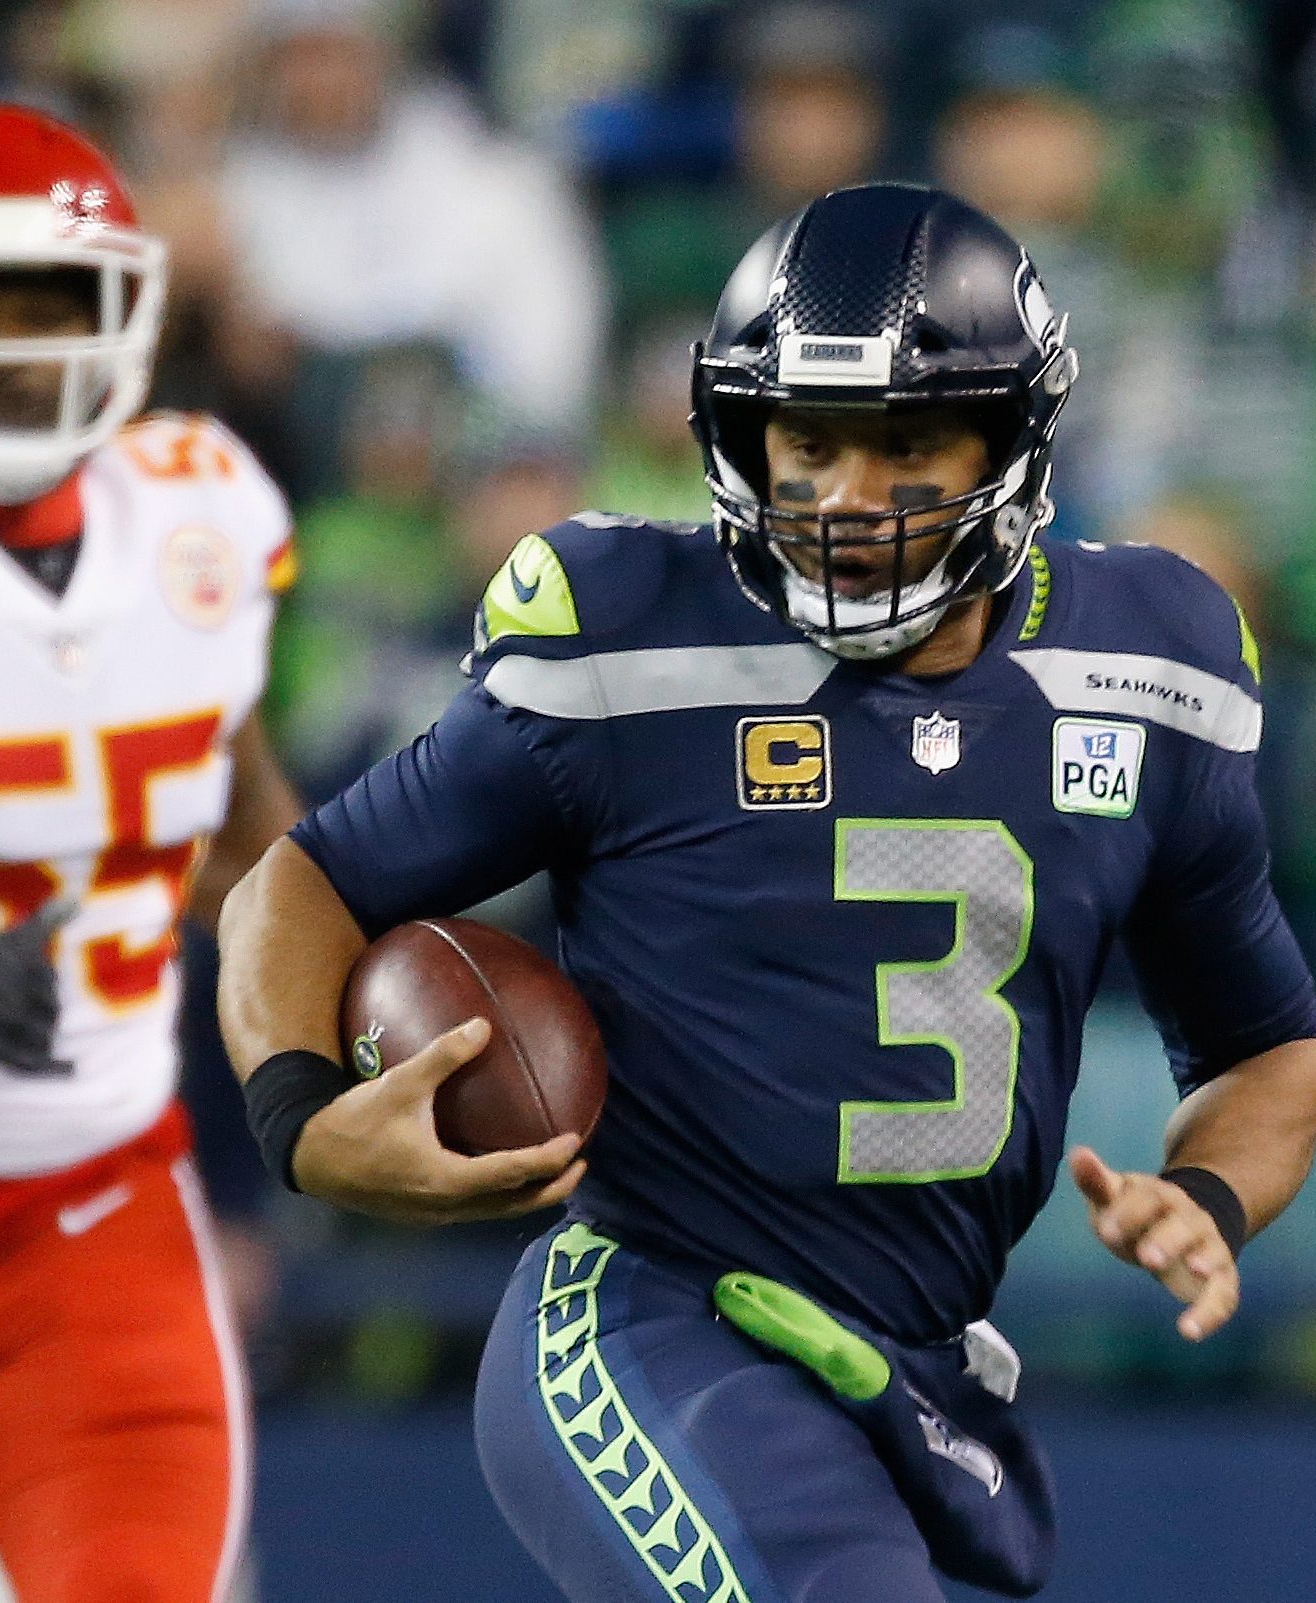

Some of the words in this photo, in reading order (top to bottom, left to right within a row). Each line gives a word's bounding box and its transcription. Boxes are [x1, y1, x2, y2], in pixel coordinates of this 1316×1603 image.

[1085, 673, 1204, 713] SEAHAWKS
[745, 722, 823, 785] C
[1089, 734, 1113, 757] 12
[1062, 761, 1129, 803] PGA
[833, 817, 1034, 1185] 3
